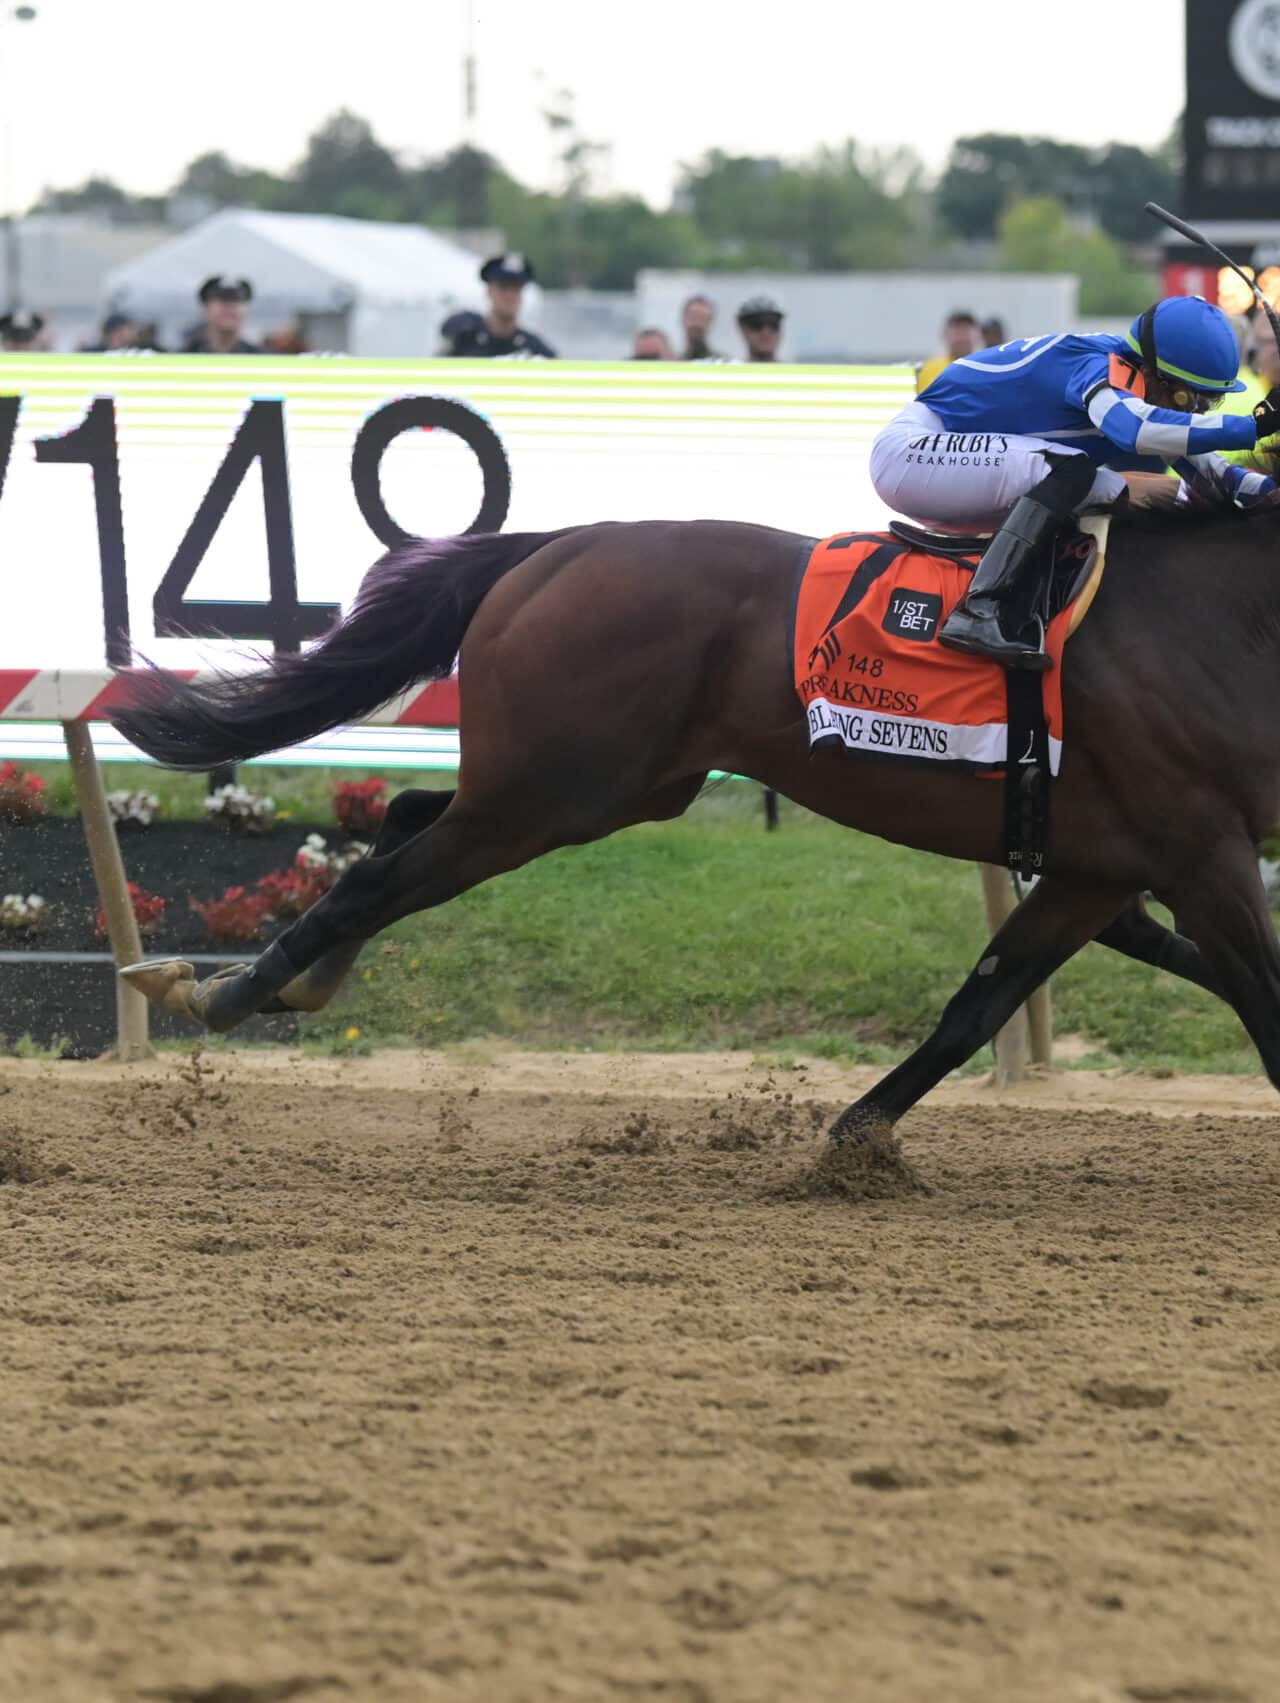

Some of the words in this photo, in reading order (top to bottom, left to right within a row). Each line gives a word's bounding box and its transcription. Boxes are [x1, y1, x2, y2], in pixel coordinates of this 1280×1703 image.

[906, 454, 1001, 467] SEAKHOUSE
[893, 600, 928, 616] 1/ST
[900, 614, 934, 631] BET
[847, 654, 884, 678] 148
[869, 719, 948, 754] SEVENS
